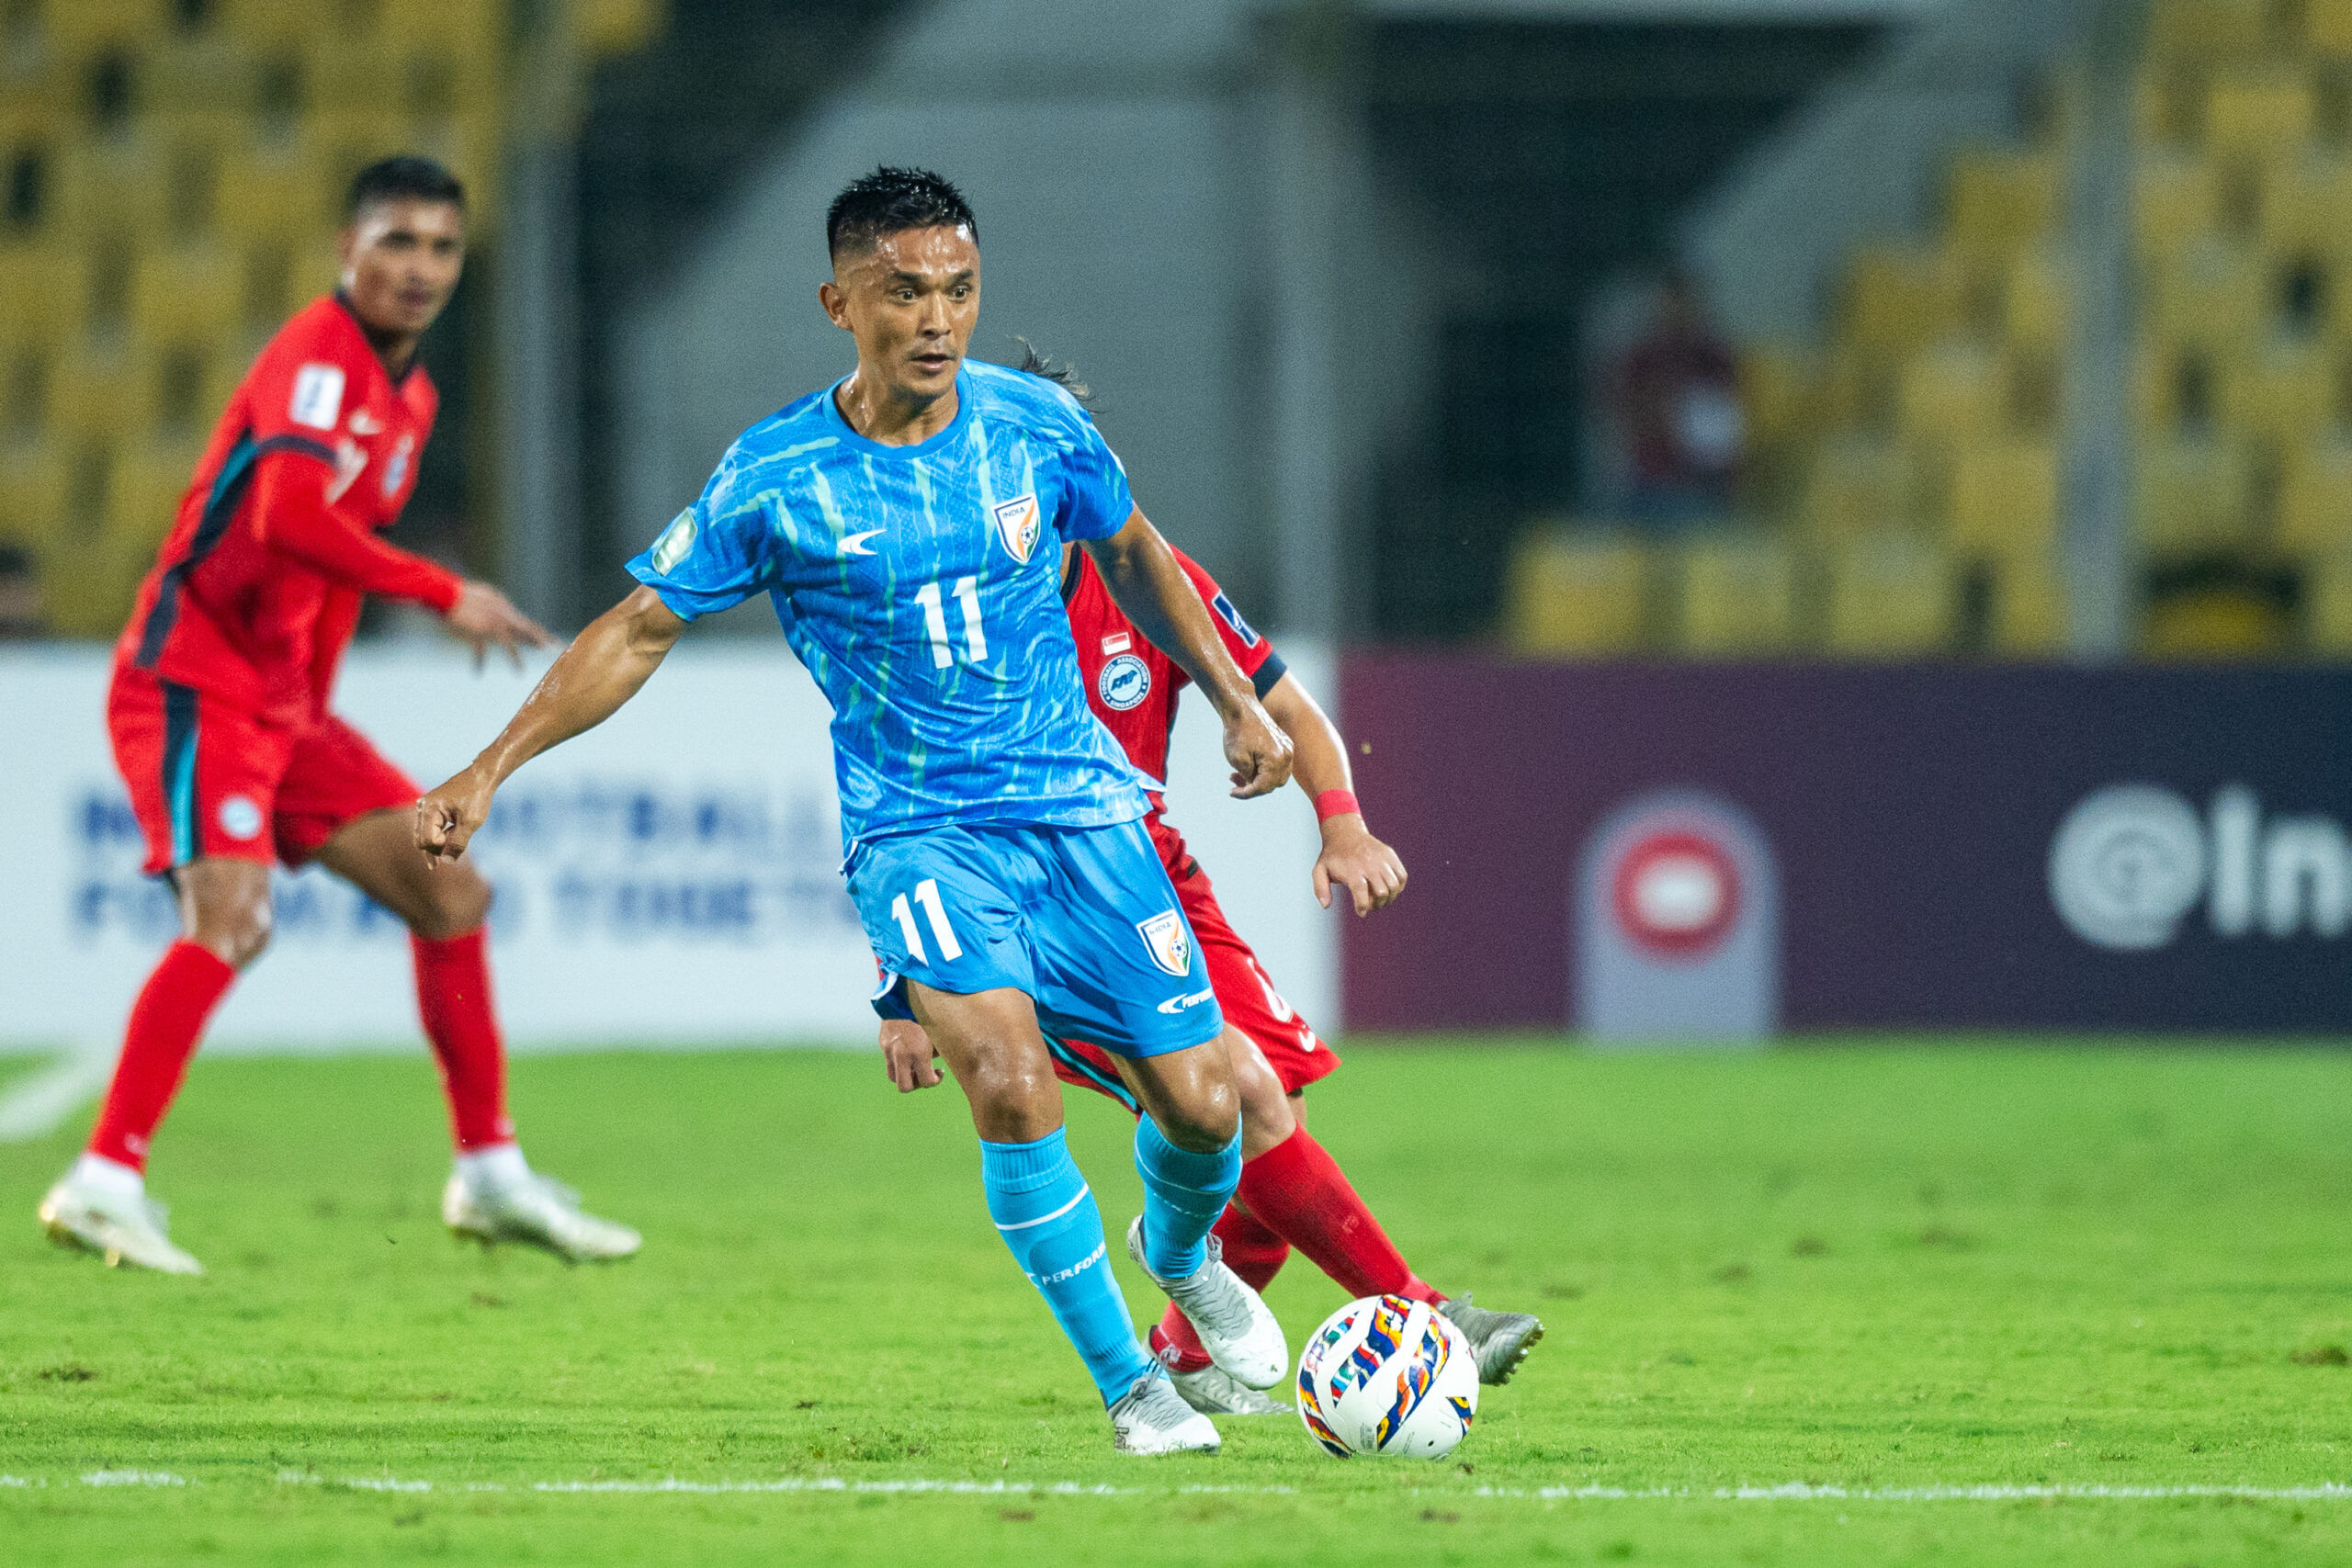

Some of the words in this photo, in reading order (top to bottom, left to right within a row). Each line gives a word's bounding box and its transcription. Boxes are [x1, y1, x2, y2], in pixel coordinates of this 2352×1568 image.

[1002, 506, 1025, 519] INDIA
[914, 576, 988, 669] 11
[889, 878, 963, 967] 11
